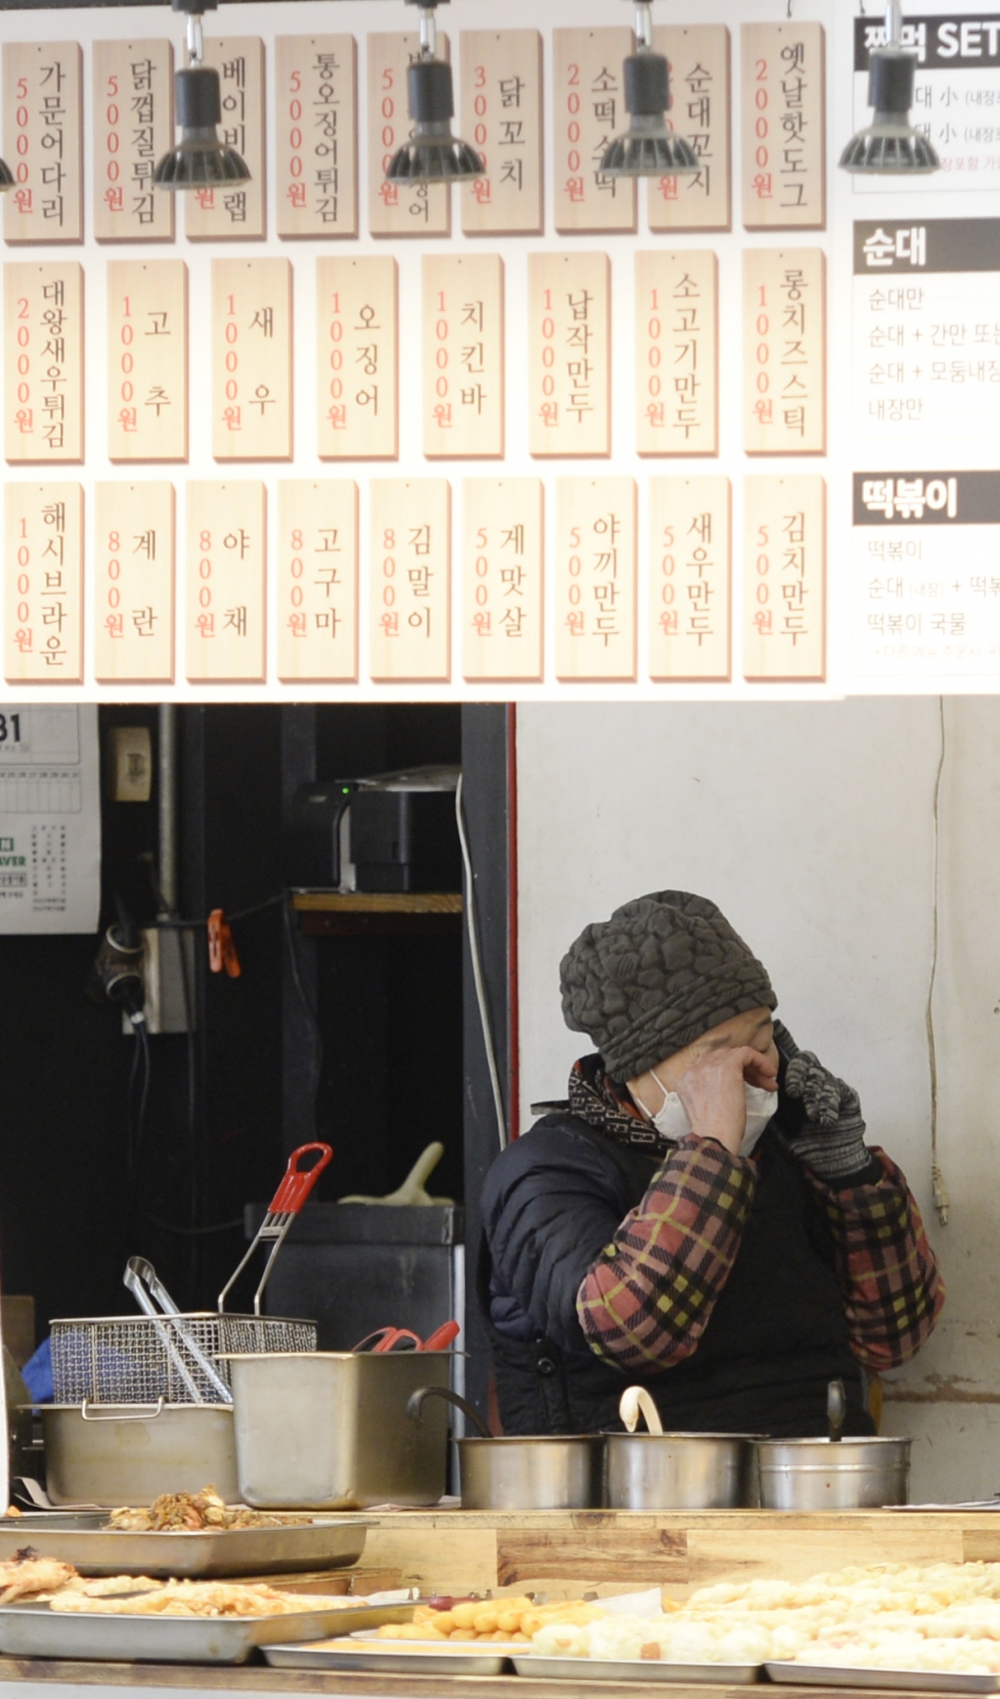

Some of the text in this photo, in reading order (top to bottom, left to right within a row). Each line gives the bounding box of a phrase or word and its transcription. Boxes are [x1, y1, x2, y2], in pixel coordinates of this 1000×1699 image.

[937, 21, 1000, 57] SET
[13, 78, 34, 214] 5000원
[39, 62, 66, 226] 가문어다리
[103, 75, 124, 212] 5000원
[130, 59, 156, 224] 닭껍질튀김
[222, 57, 246, 222] 베이비랩
[287, 71, 307, 208] 5000원
[313, 54, 339, 222] 통오징어튀김
[499, 76, 525, 190] 닭꼬치
[564, 64, 585, 203] 2000원
[685, 63, 712, 196] 순대꼬지
[752, 59, 773, 199] 2000원
[780, 43, 807, 206] 옛날핫도그
[915, 85, 932, 108] 대
[940, 85, 958, 107] 小
[939, 123, 957, 144] 小
[941, 156, 979, 171] 장포함
[863, 227, 926, 266] 순대
[868, 288, 924, 311] 순대만
[14, 298, 34, 434] 2000원
[41, 280, 67, 448] 대왕새우튀김
[117, 296, 137, 432] 1000원
[145, 312, 170, 416] 고추
[222, 294, 242, 431] 1000원
[250, 307, 275, 414] 새우
[327, 292, 347, 429] 1000원
[355, 304, 380, 415] 오징어
[433, 290, 452, 428] 1000원
[462, 301, 486, 414] 치킨바
[539, 288, 559, 426] 1000원
[567, 289, 593, 422] 납작만두
[645, 289, 665, 427] 1000원
[673, 273, 700, 438] 소고기만두
[753, 285, 773, 424] 1000원
[780, 269, 808, 436] 롱치즈스틱
[868, 324, 905, 348] 순대
[930, 323, 967, 346] 간만
[868, 361, 905, 384] 순대
[869, 398, 923, 421] 내장만
[862, 478, 958, 519] 떡볶이
[868, 540, 922, 562] 떡볶이
[13, 518, 34, 653] 1000원
[40, 502, 66, 665] 해시브라운
[104, 531, 124, 638] 800원
[133, 530, 157, 636] 계란
[195, 530, 215, 638] 800원
[224, 529, 249, 636] 야채
[287, 529, 307, 638] 800원
[315, 529, 341, 638] 고구마
[379, 529, 399, 637] 800원
[408, 525, 433, 637] 김말이
[471, 528, 492, 637] 500원
[501, 524, 526, 637] 게맛살
[564, 527, 585, 636] 500원
[593, 514, 620, 646] 야끼만두
[658, 526, 679, 636] 500원
[686, 513, 713, 646] 새우만두
[752, 525, 773, 636] 500원
[781, 512, 808, 646] 김치만두
[868, 576, 903, 599] 순대
[868, 612, 966, 635] 떡볶이 국물
